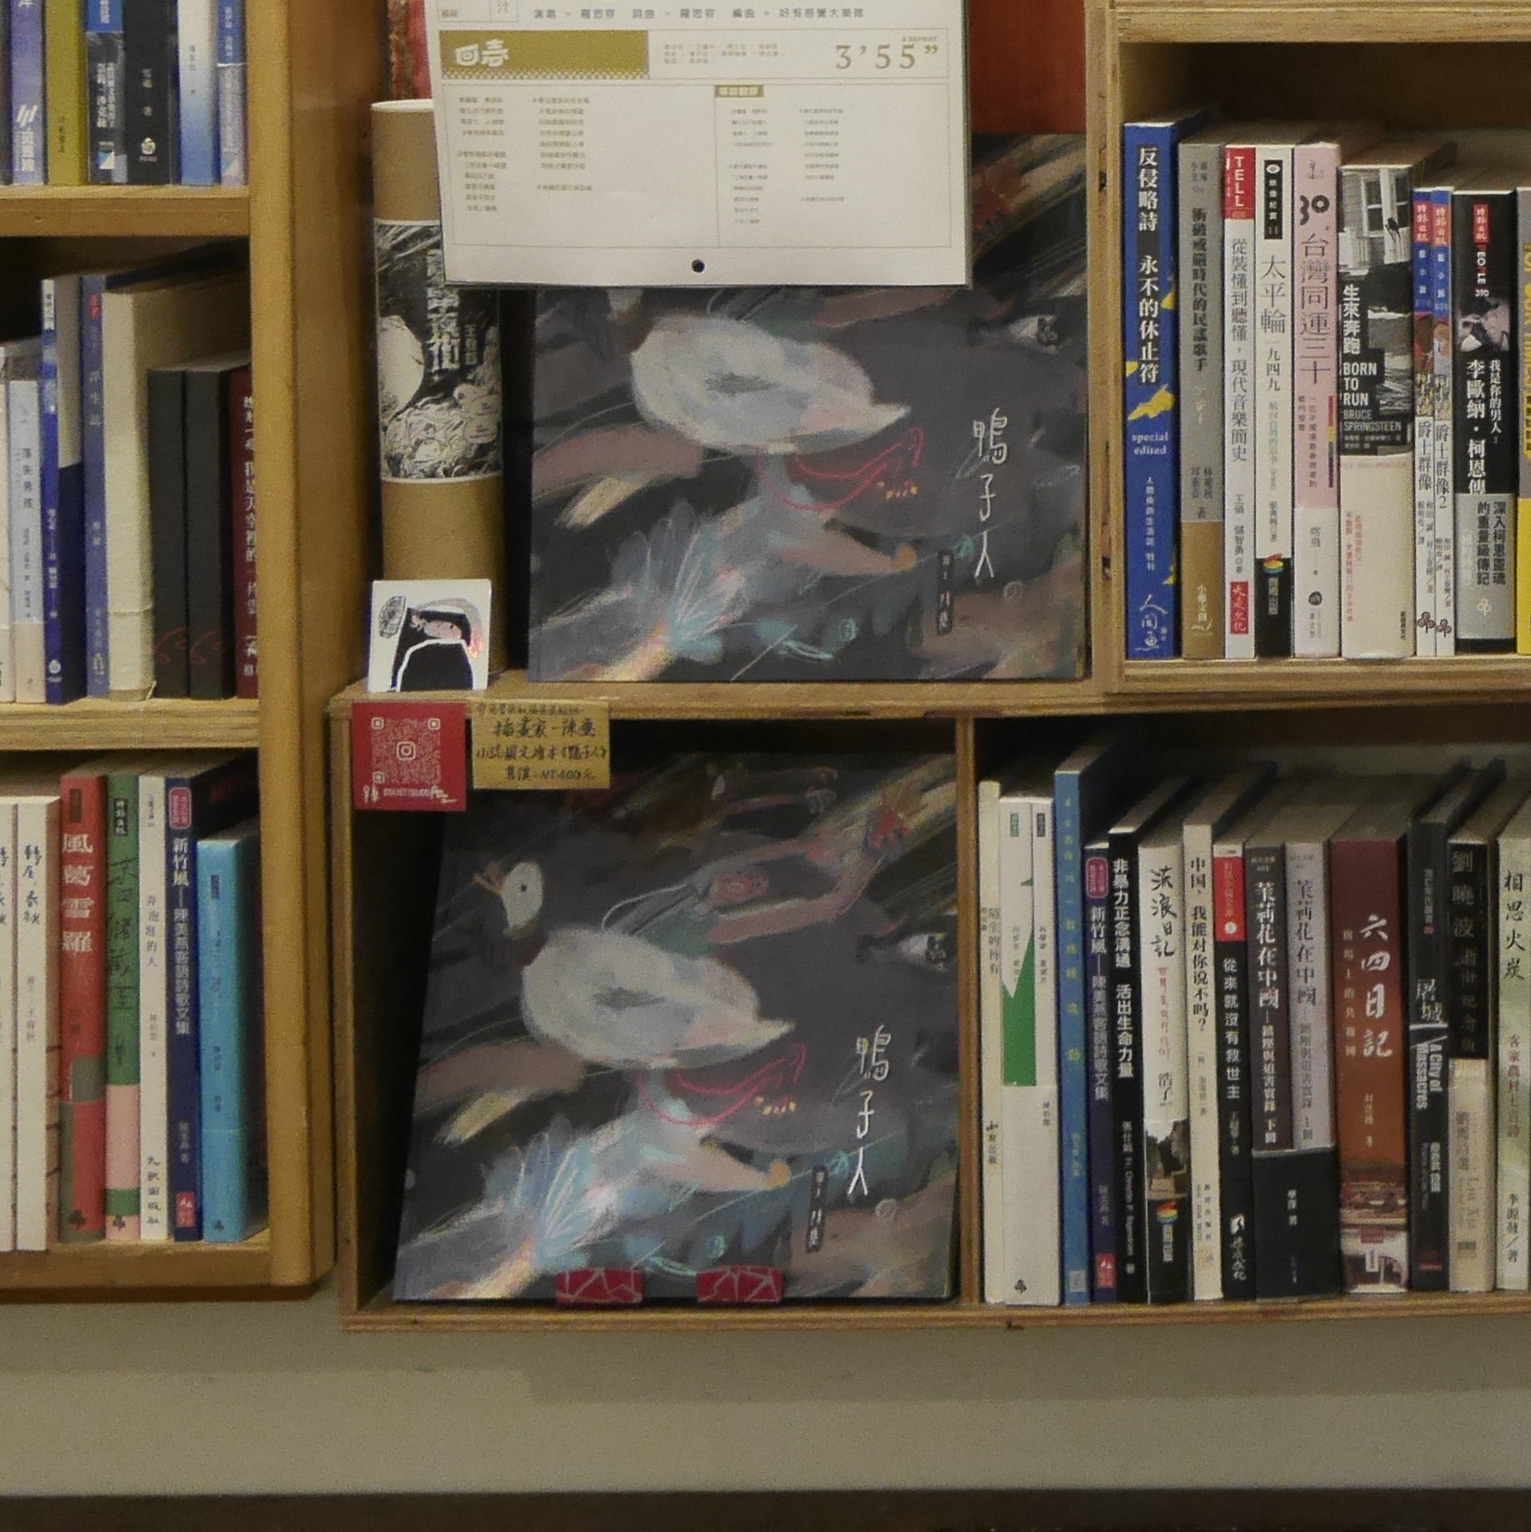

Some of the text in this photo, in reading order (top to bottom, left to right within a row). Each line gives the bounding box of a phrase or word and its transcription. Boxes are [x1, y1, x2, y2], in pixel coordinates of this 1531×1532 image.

[1234, 156, 1246, 208] TELL
[1138, 147, 1160, 383] 反侵略詩 永不的休止符
[1231, 237, 1249, 462] 從裝懂到聽懂，現代音樂簡史
[1260, 254, 1286, 392] 太平輪 一九四九
[1299, 232, 1331, 385] 台灣同運三十
[1343, 285, 1361, 355] 生來奔跑
[1342, 377, 1359, 389] TO
[1342, 393, 1369, 406] RUN
[1343, 362, 1377, 376] BORN
[1131, 431, 1169, 444] special
[1133, 445, 1167, 455] edited
[1343, 409, 1372, 419] BRUCE
[1343, 421, 1401, 431] SPRINGSTEEN
[1417, 421, 1432, 491] 爵士群像
[972, 407, 1009, 581] 鴨子人
[1434, 425, 1450, 509] 爵士群像2
[1477, 501, 1490, 585] 的重量級傳記
[1150, 865, 1178, 958] 流浪日記
[1254, 881, 1280, 1009] 茉莉花在中國
[1503, 871, 1526, 981] 相思火炭
[1222, 957, 1241, 1099] 從來就沒有救世主
[1360, 914, 1393, 1058] 六四日記
[1116, 984, 1133, 1078] 活出生命力量
[848, 1024, 892, 1196] 鴨子人
[1416, 1043, 1428, 1110] Massacres
